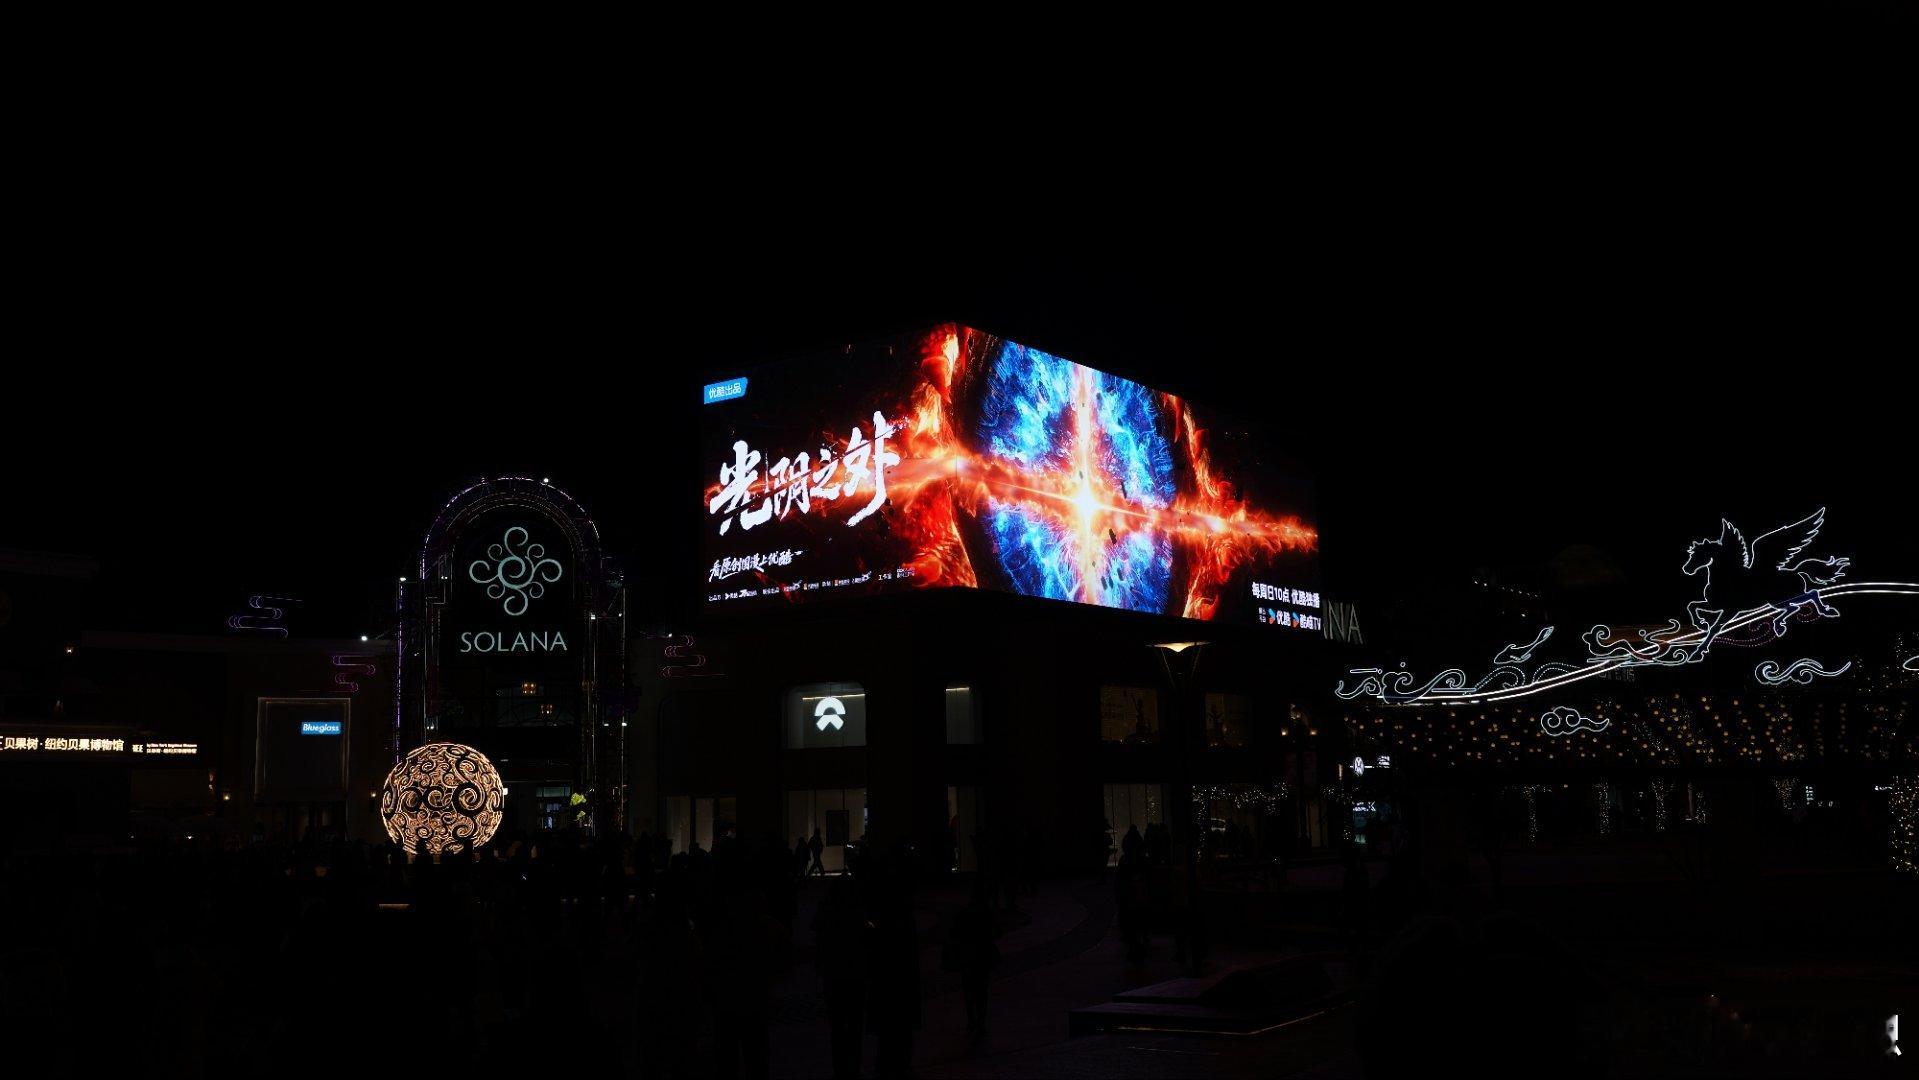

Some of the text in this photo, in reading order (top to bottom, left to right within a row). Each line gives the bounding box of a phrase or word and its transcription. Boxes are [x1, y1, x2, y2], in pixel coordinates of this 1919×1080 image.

[708, 382, 742, 399] 优酷出品
[709, 410, 901, 536] 光阴之外
[460, 631, 568, 653] SOLANA
[303, 723, 340, 734] Blueglass
